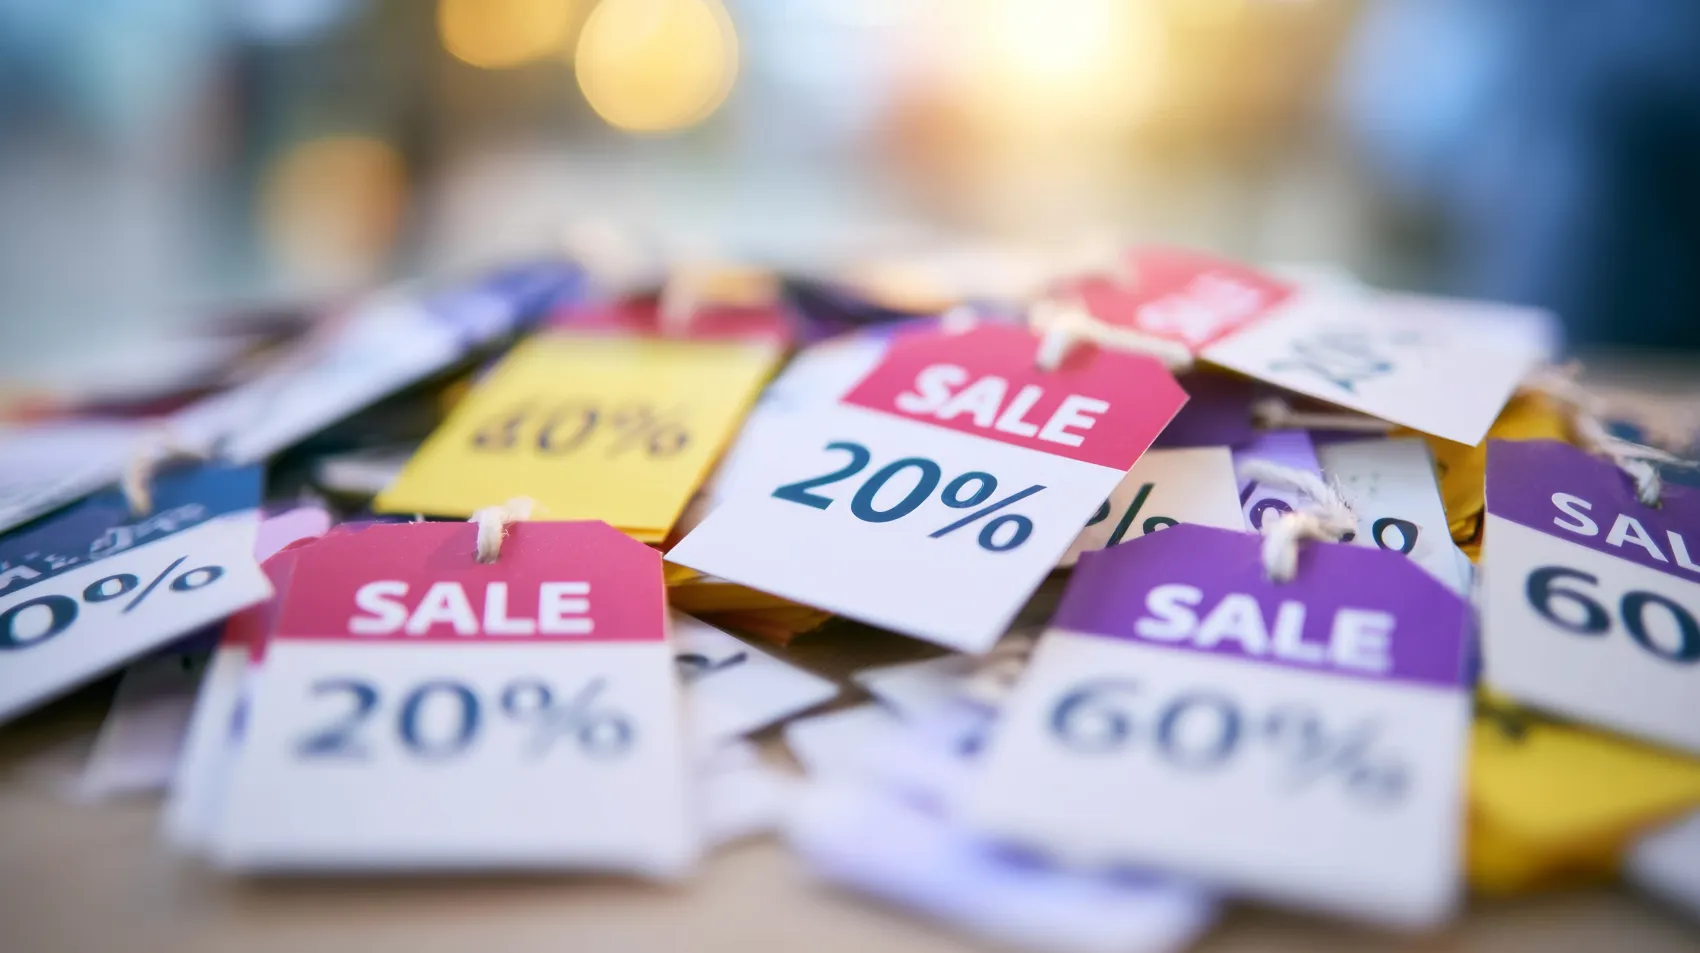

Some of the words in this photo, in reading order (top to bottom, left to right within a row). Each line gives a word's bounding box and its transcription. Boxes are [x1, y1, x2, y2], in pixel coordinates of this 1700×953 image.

[897, 364, 1112, 447] SALE
[771, 440, 1047, 552] 20%
[348, 579, 594, 635] SALE
[1135, 584, 1396, 670] SALE
[294, 675, 636, 758] 20%
[1047, 677, 1412, 806] 60%
